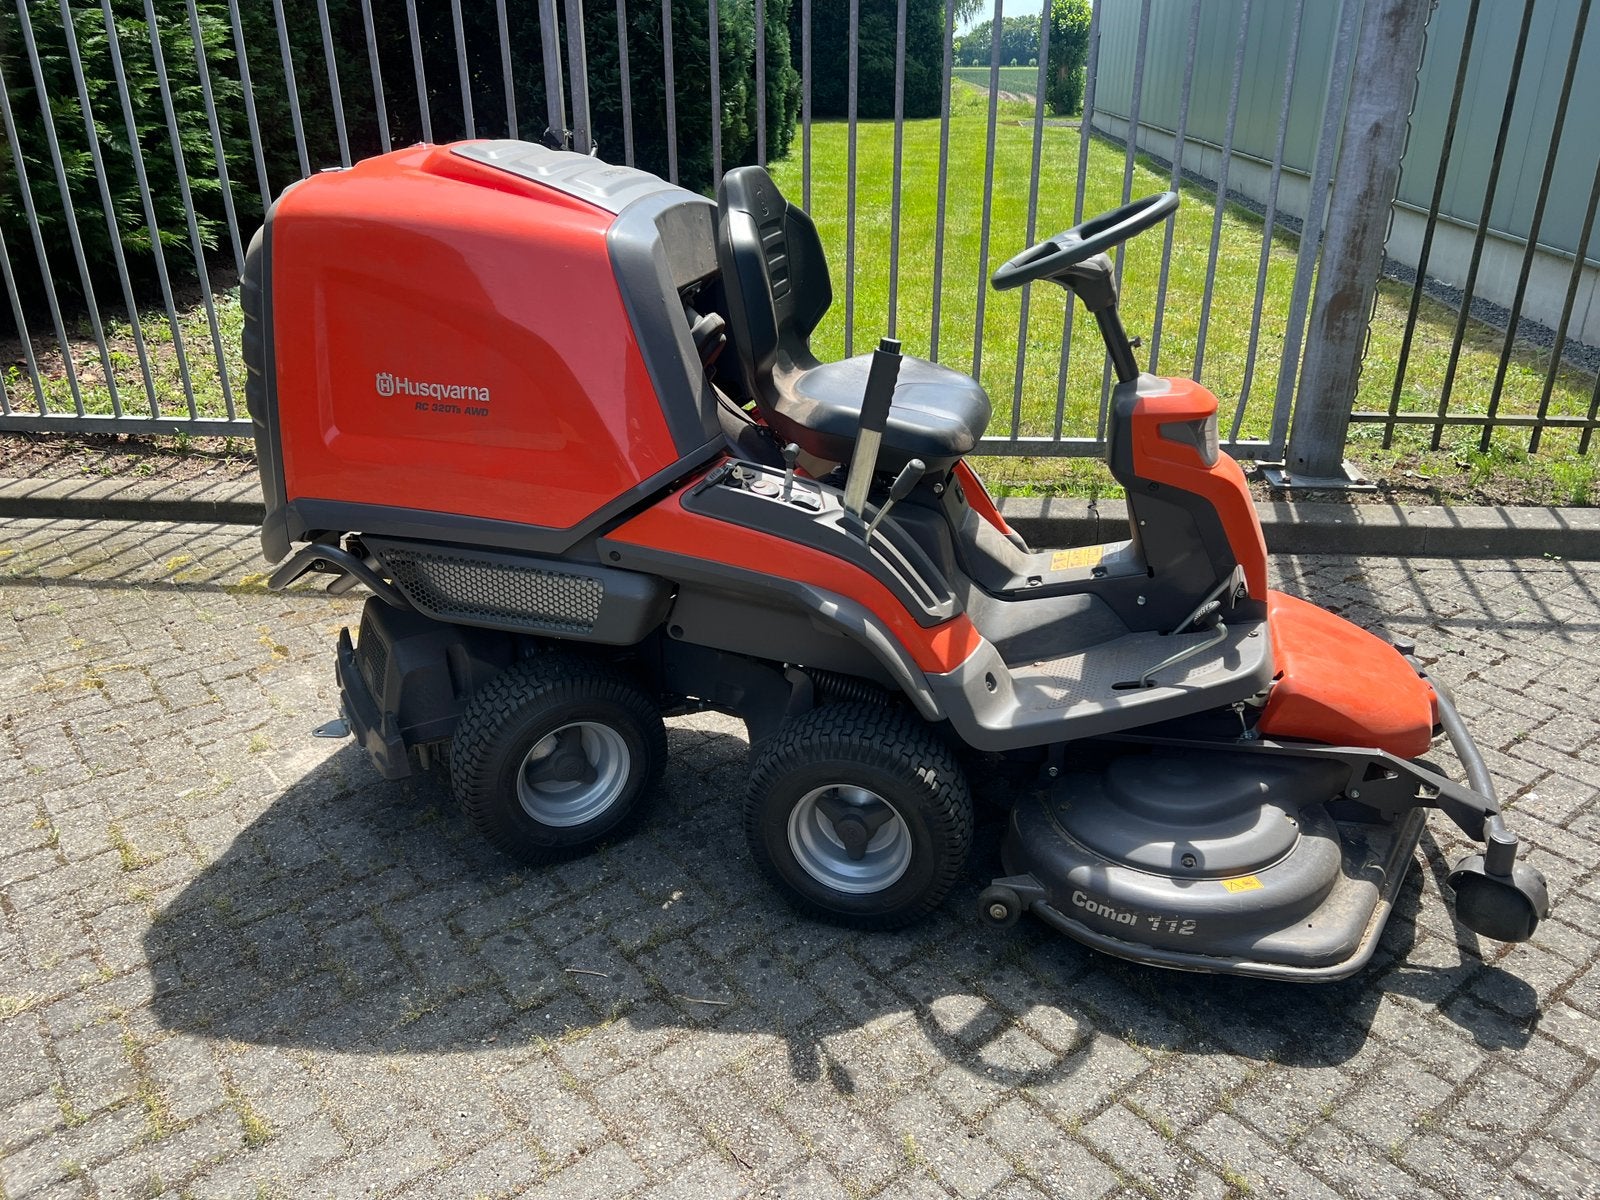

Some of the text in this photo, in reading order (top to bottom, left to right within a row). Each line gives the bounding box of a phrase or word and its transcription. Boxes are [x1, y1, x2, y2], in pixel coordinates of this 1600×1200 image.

[395, 376, 490, 401] Husqvarna
[415, 402, 429, 411] RC
[464, 406, 489, 416] AWD
[1071, 890, 1197, 935] Combi 112
